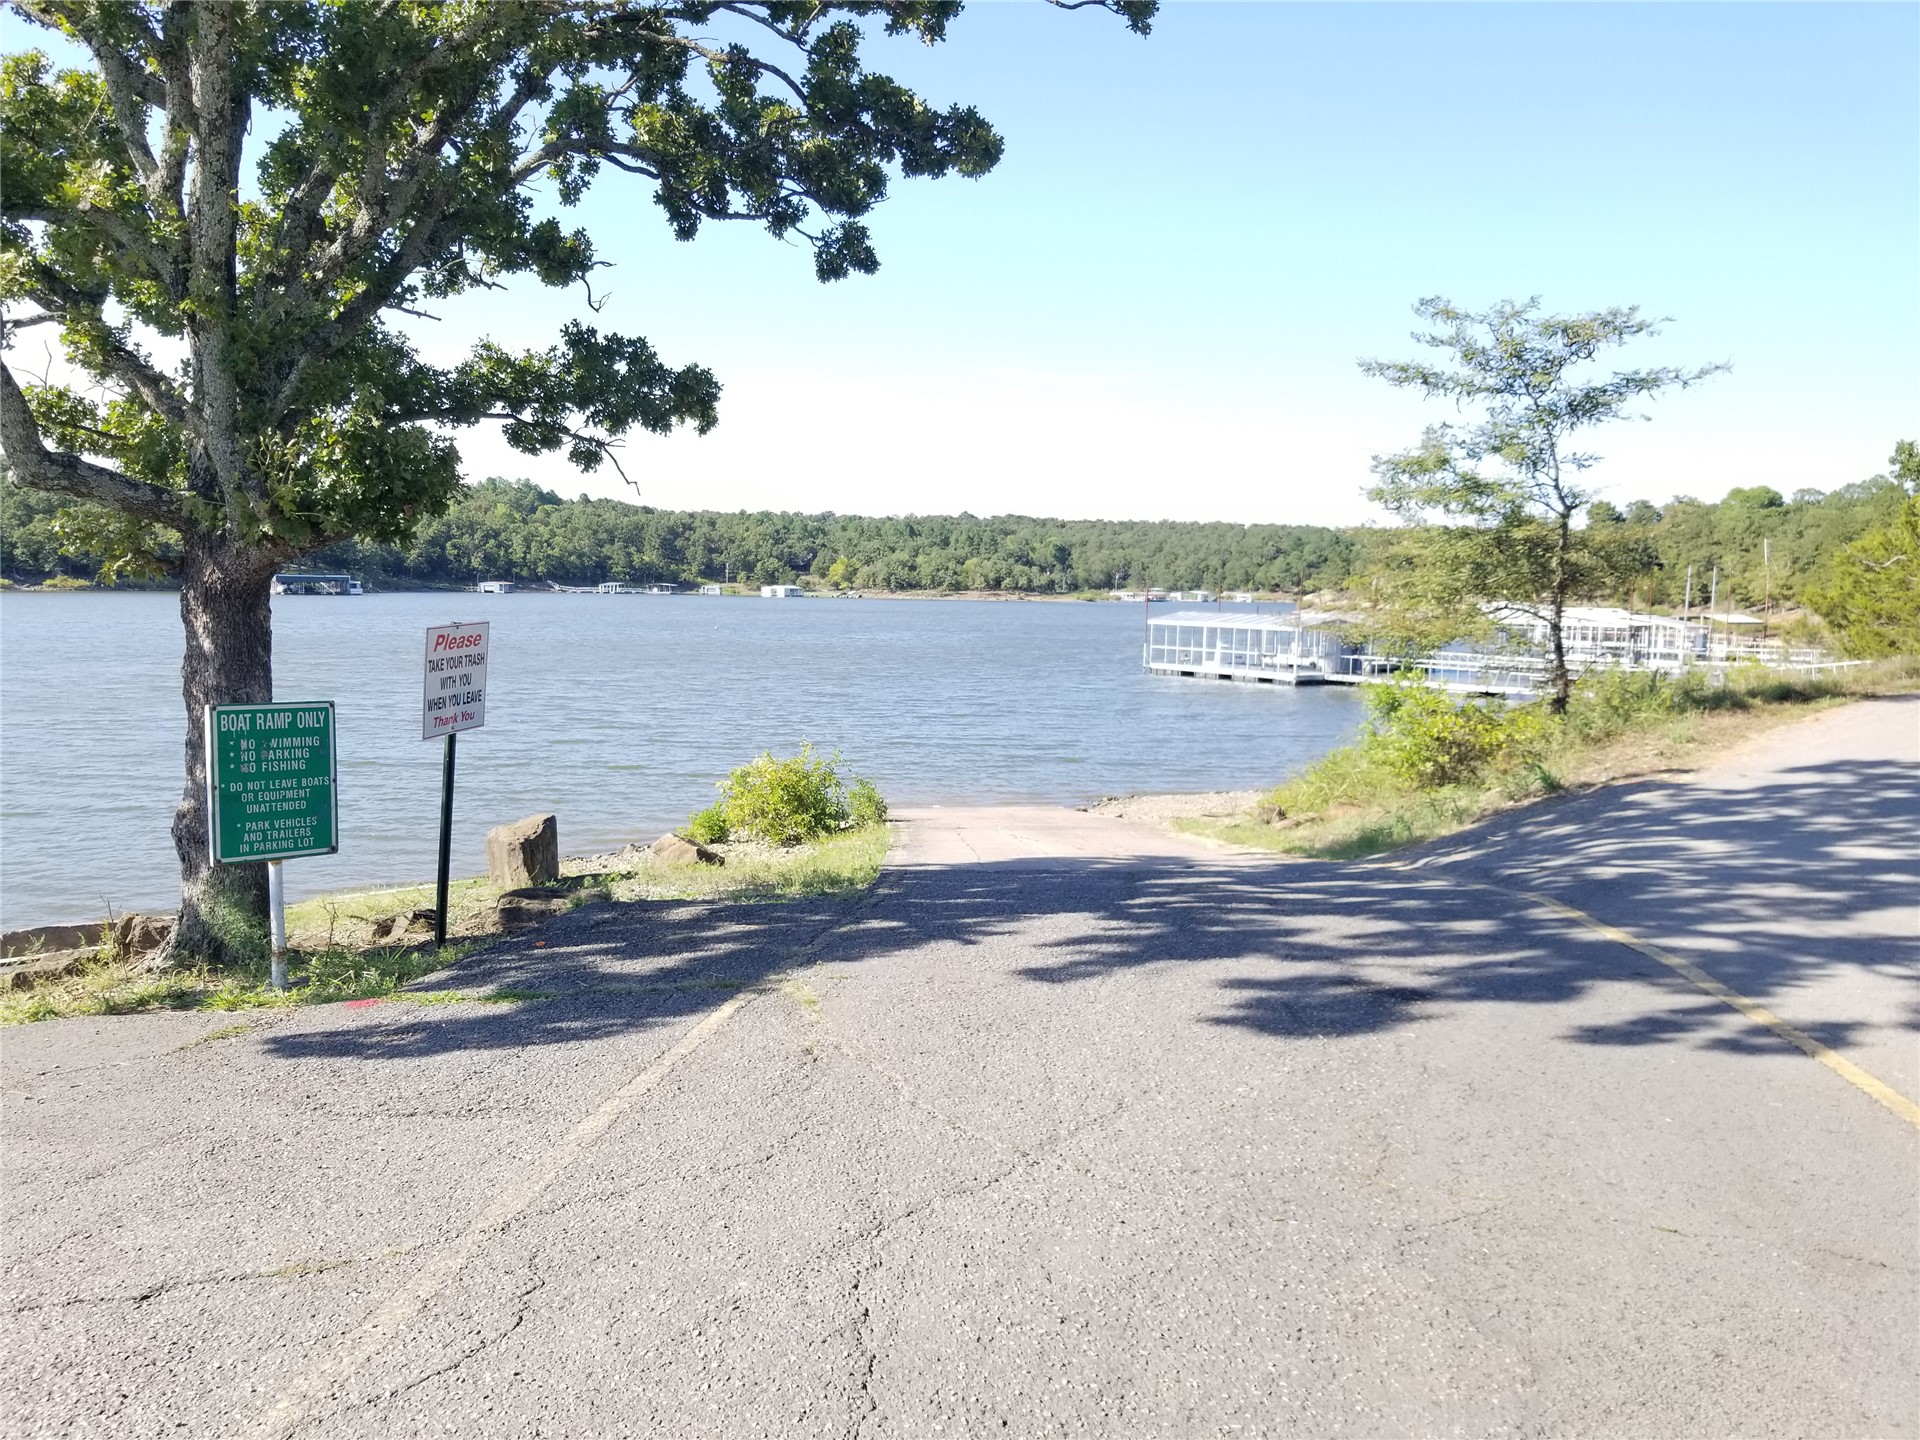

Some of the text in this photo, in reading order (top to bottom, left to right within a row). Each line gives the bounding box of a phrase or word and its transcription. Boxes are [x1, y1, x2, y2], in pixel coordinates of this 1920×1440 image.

[434, 633, 482, 652] Please
[428, 653, 485, 673] TAKE YOUR TRASH
[440, 673, 472, 690] WITH YOU
[428, 690, 482, 712] WHEN YOU LEAVE
[221, 712, 325, 732] BOAT RAMP ONLY
[434, 710, 475, 728] Thank You
[261, 736, 320, 748] WIMMING
[241, 751, 255, 761] NO
[262, 760, 306, 772] FISHING
[230, 777, 330, 792] DO NOT LEAVE BOATS
[242, 789, 310, 802] OR EQUIPMENT
[246, 801, 306, 814] UNATTENDED
[246, 816, 317, 831] PARK VEHICLES
[244, 828, 311, 842] AND TRAILERS
[240, 838, 314, 853] IN PARKING LOT
